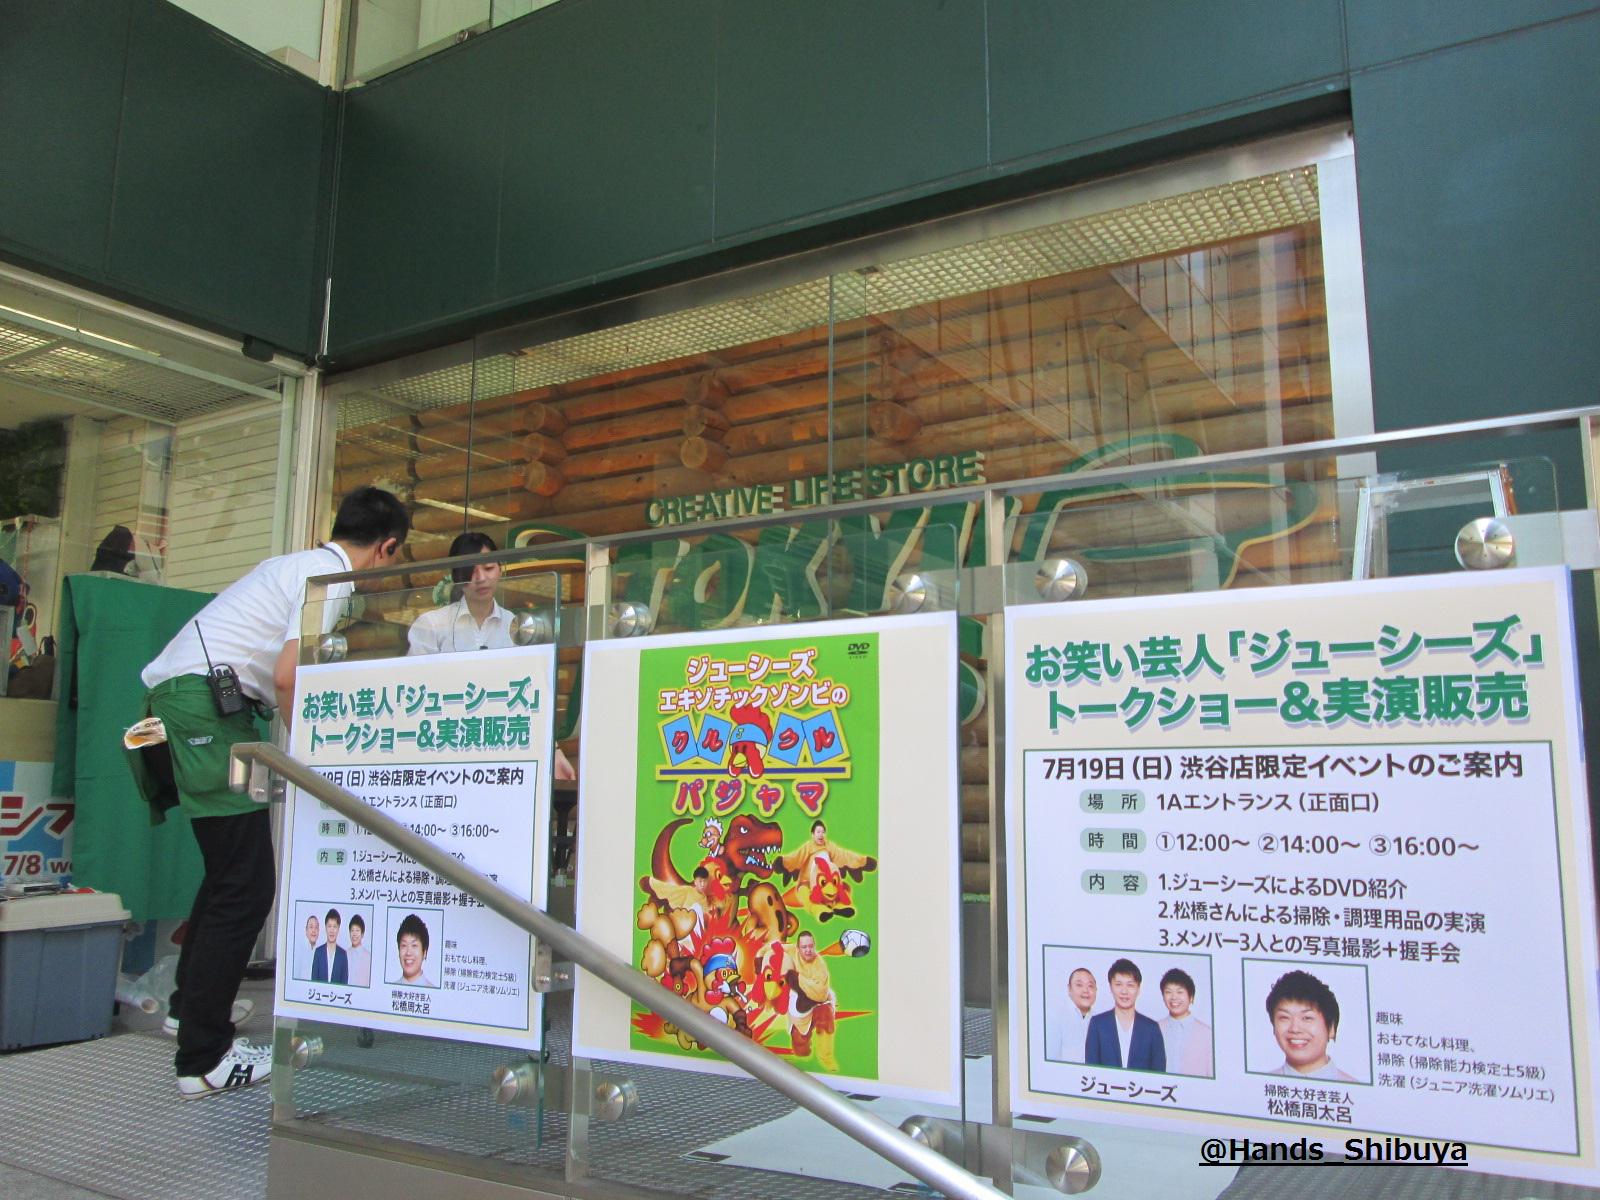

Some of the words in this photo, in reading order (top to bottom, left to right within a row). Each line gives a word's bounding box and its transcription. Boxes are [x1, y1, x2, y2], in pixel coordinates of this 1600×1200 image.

[645, 485, 784, 527] CREATIVE
[789, 469, 864, 506] LIFE
[865, 451, 986, 498] STORE
[848, 642, 870, 651] DVD
[1024, 613, 1544, 684] お笑い芸人「ジューシーズ」
[686, 648, 816, 684] ジューシーズ
[302, 676, 540, 721] お笑い芸人「ジューシーズ」
[659, 681, 849, 712] エキゾチックゾンビの
[1049, 670, 1530, 731] トークショー&実演販売
[309, 713, 531, 753] トークショー&実演販売
[675, 778, 826, 813] パジャマ
[4, 854, 41, 876] 7/8
[1158, 872, 1407, 900] 1.ジューシーズによるDVD紹介
[1158, 900, 1486, 934] 2.松橋さんによる掃除・調理用品の実演
[307, 987, 353, 1005] ジューシーズ
[391, 1000, 431, 1015] 松橋周太呂
[1376, 1011, 1404, 1026] 趣味
[1080, 1074, 1178, 1103] ジューシーズ
[1264, 1083, 1354, 1106] 掃除大好き芸人
[1267, 1098, 1352, 1124] 松橋周太呂
